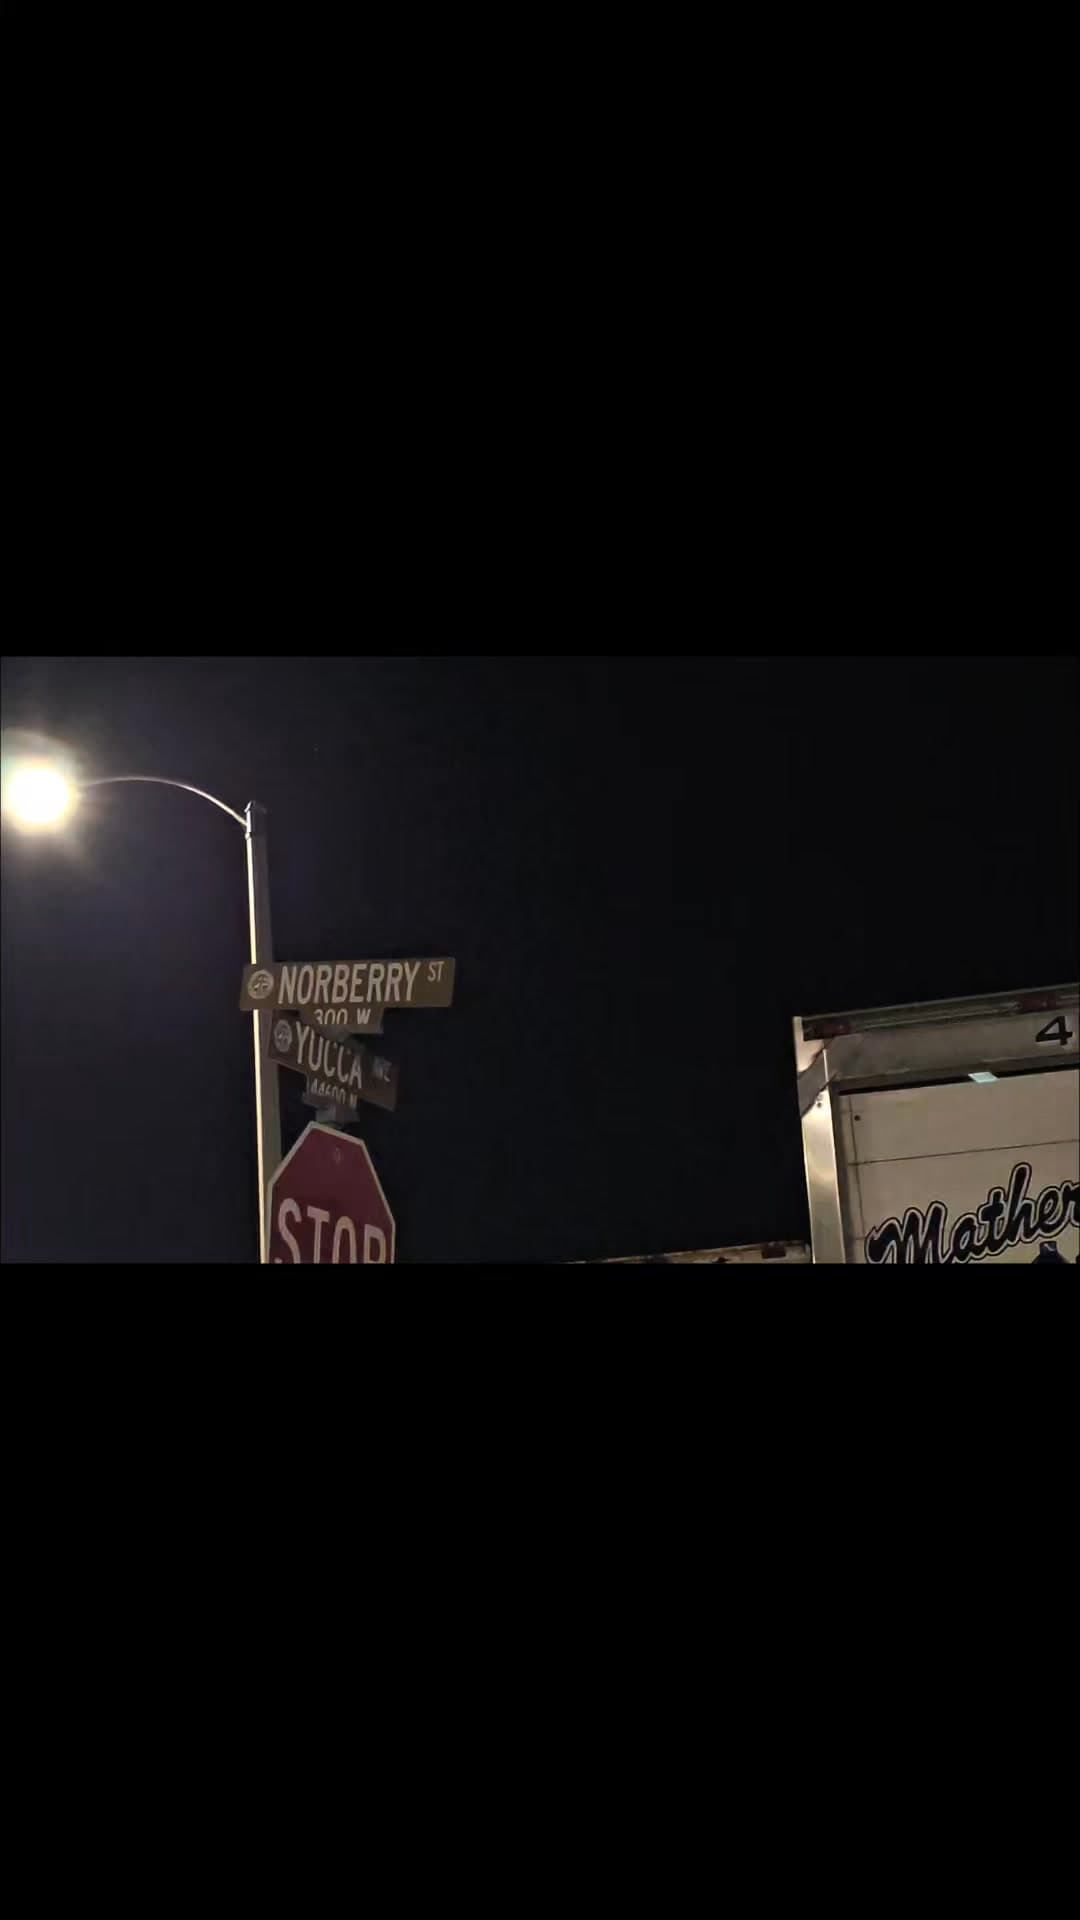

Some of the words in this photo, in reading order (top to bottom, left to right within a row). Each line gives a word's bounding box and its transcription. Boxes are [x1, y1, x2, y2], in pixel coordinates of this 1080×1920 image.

[278, 961, 421, 1005] NORBERRY
[427, 960, 445, 982] ST
[356, 1008, 371, 1025] W
[1036, 1016, 1073, 1045] 4
[296, 1020, 363, 1089] YUCCA
